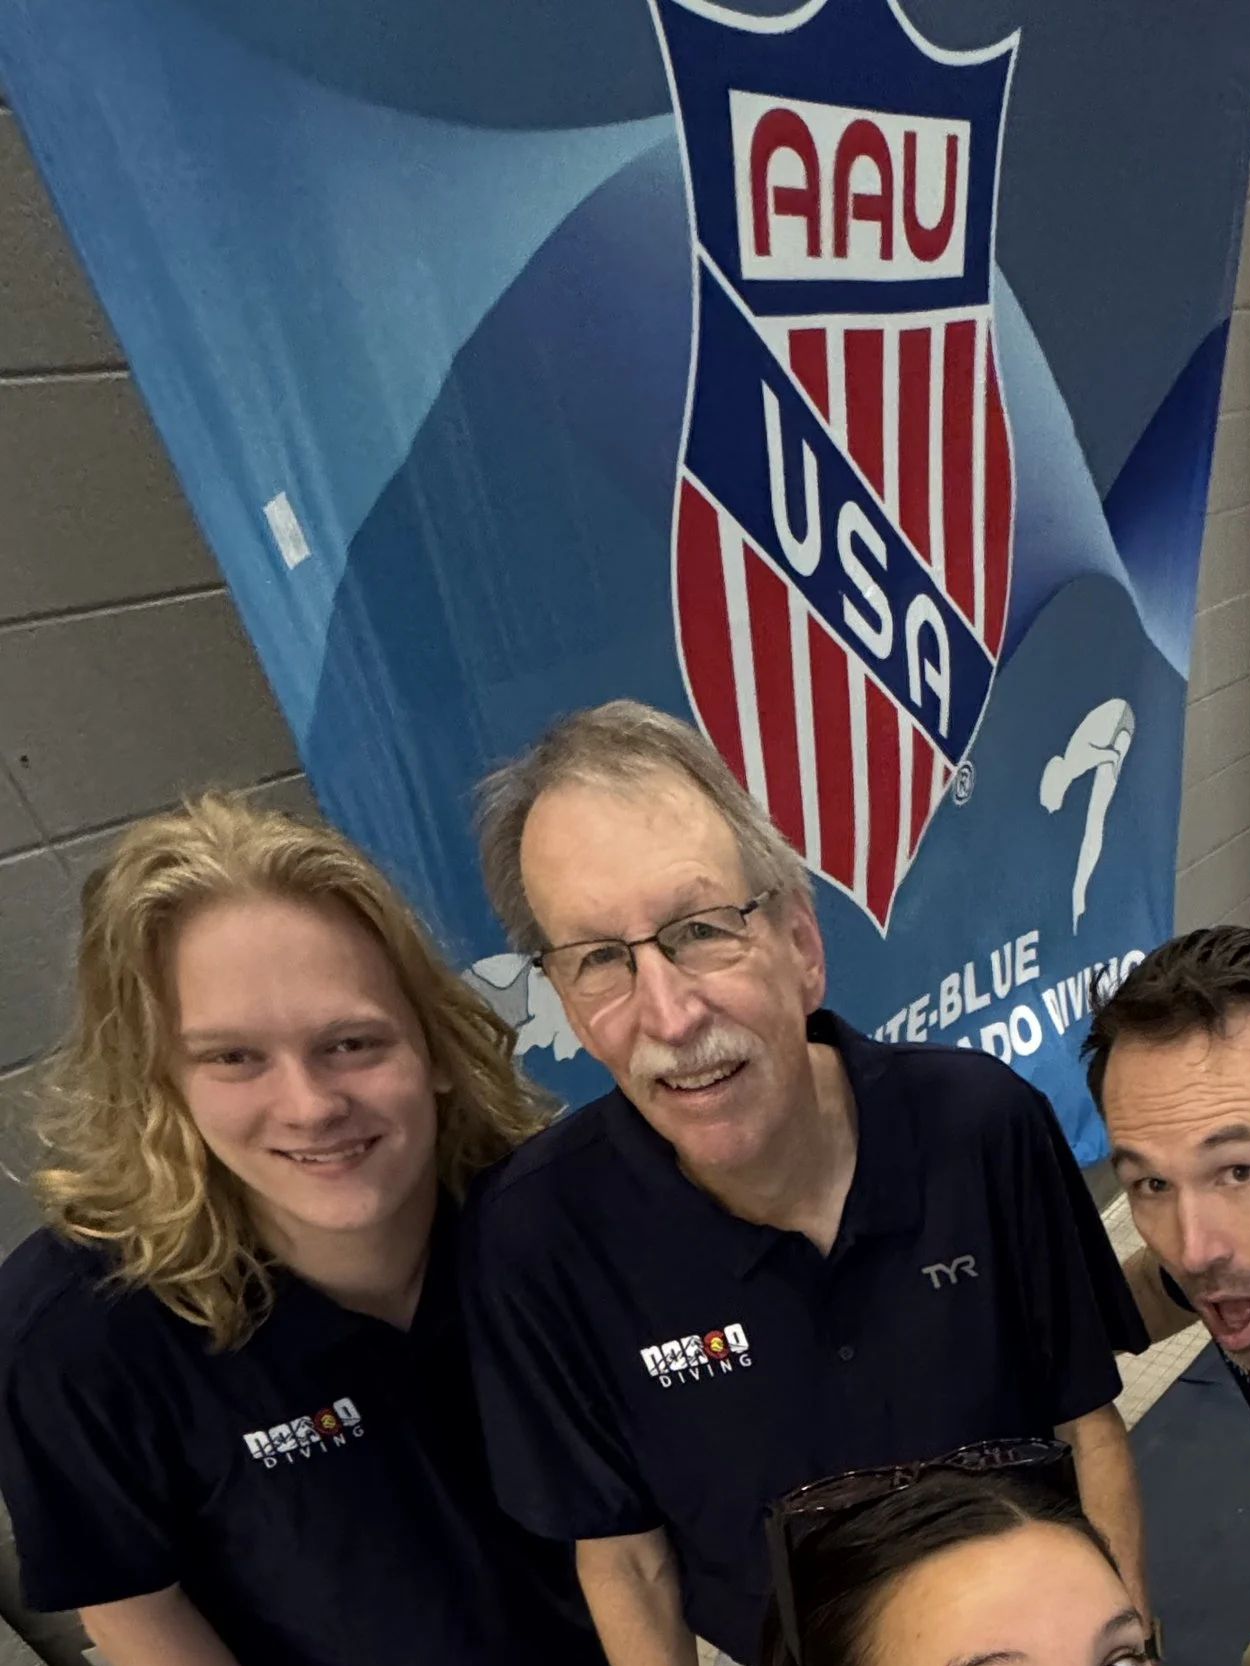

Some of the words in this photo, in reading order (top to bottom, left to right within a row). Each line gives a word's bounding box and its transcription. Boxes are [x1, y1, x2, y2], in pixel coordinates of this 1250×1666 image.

[750, 107, 959, 263] AAU
[760, 379, 951, 737] USA
[921, 1254, 979, 1289] TYR
[659, 1353, 752, 1388] DIVING
[263, 1425, 365, 1469] DIVING
